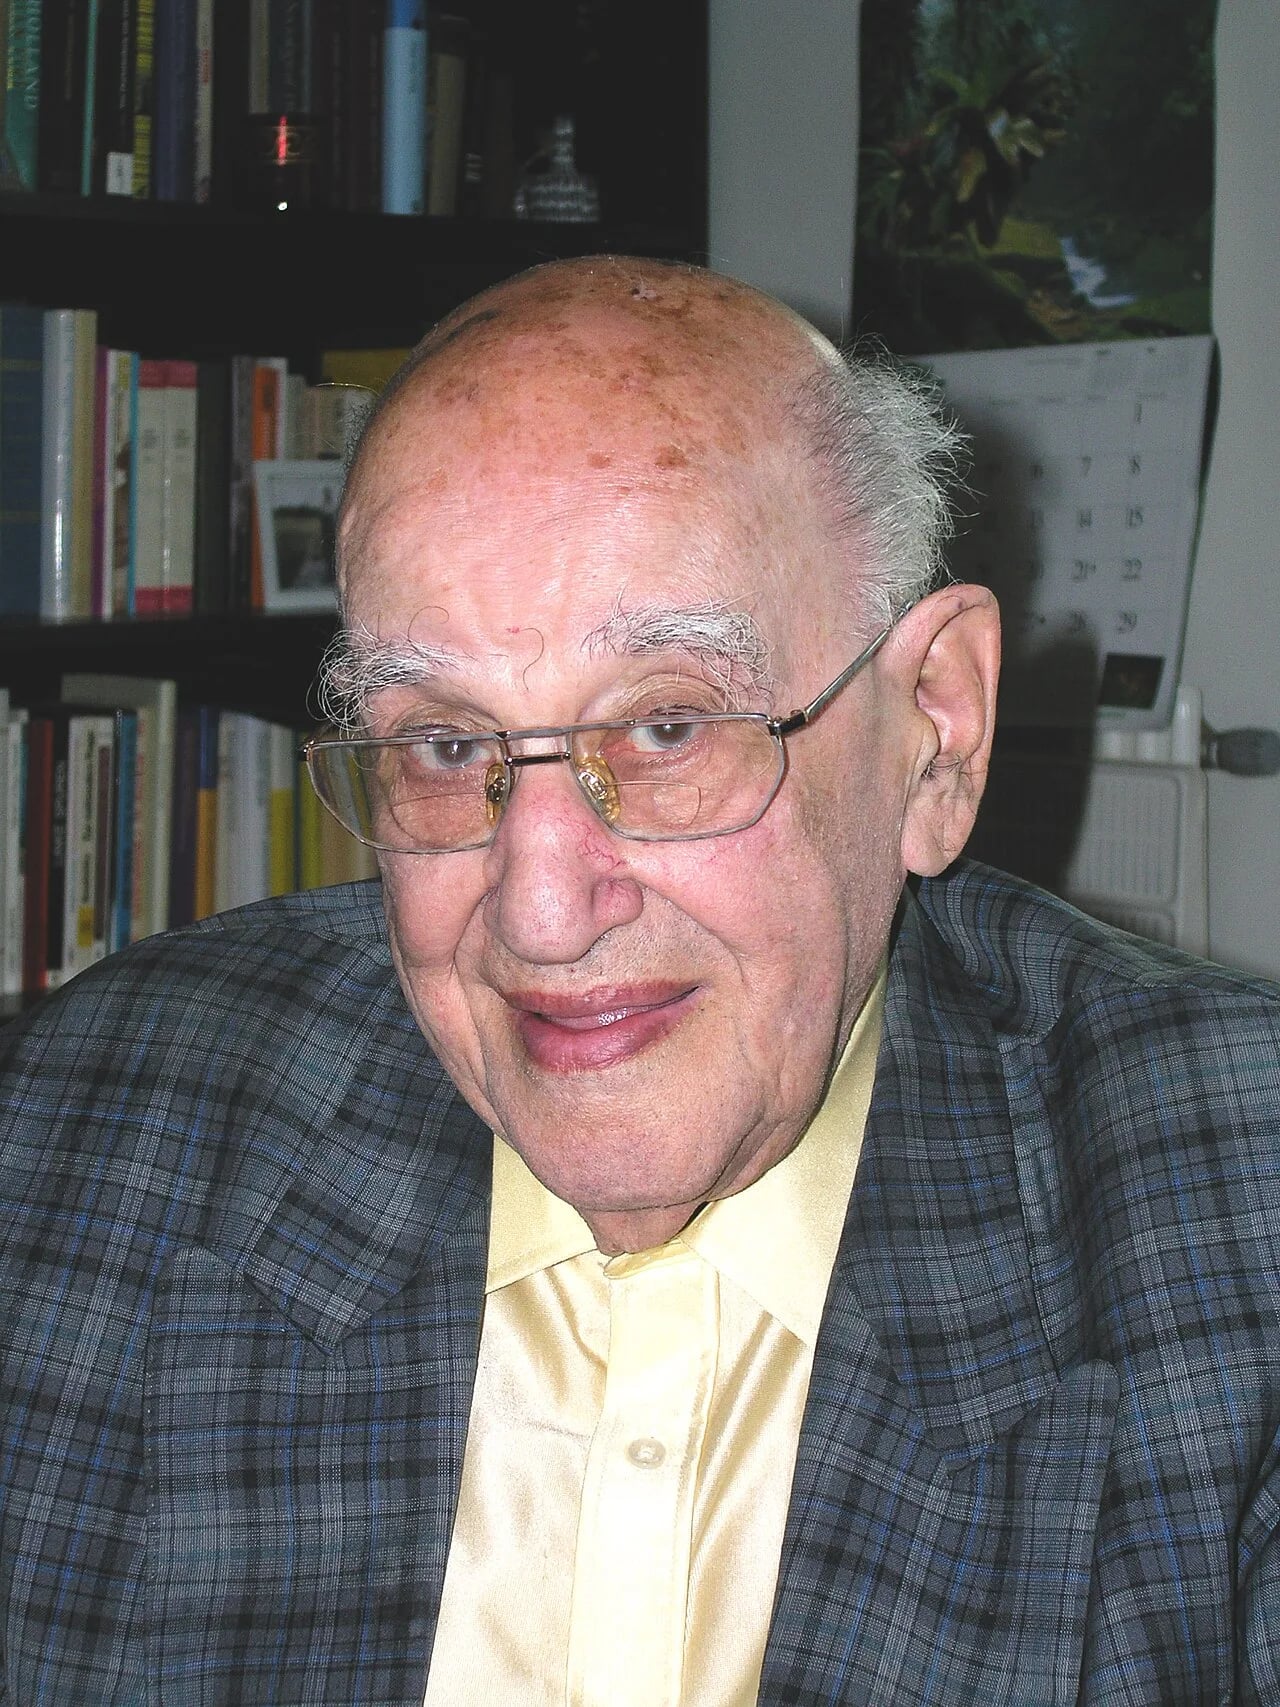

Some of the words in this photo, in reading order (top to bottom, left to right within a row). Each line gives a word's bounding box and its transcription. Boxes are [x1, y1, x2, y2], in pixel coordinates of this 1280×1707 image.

[1081, 455, 1092, 477] 7
[1129, 454, 1142, 476] 8
[1126, 506, 1143, 529] 15
[1122, 557, 1143, 580] 22
[1117, 610, 1138, 634] 29
